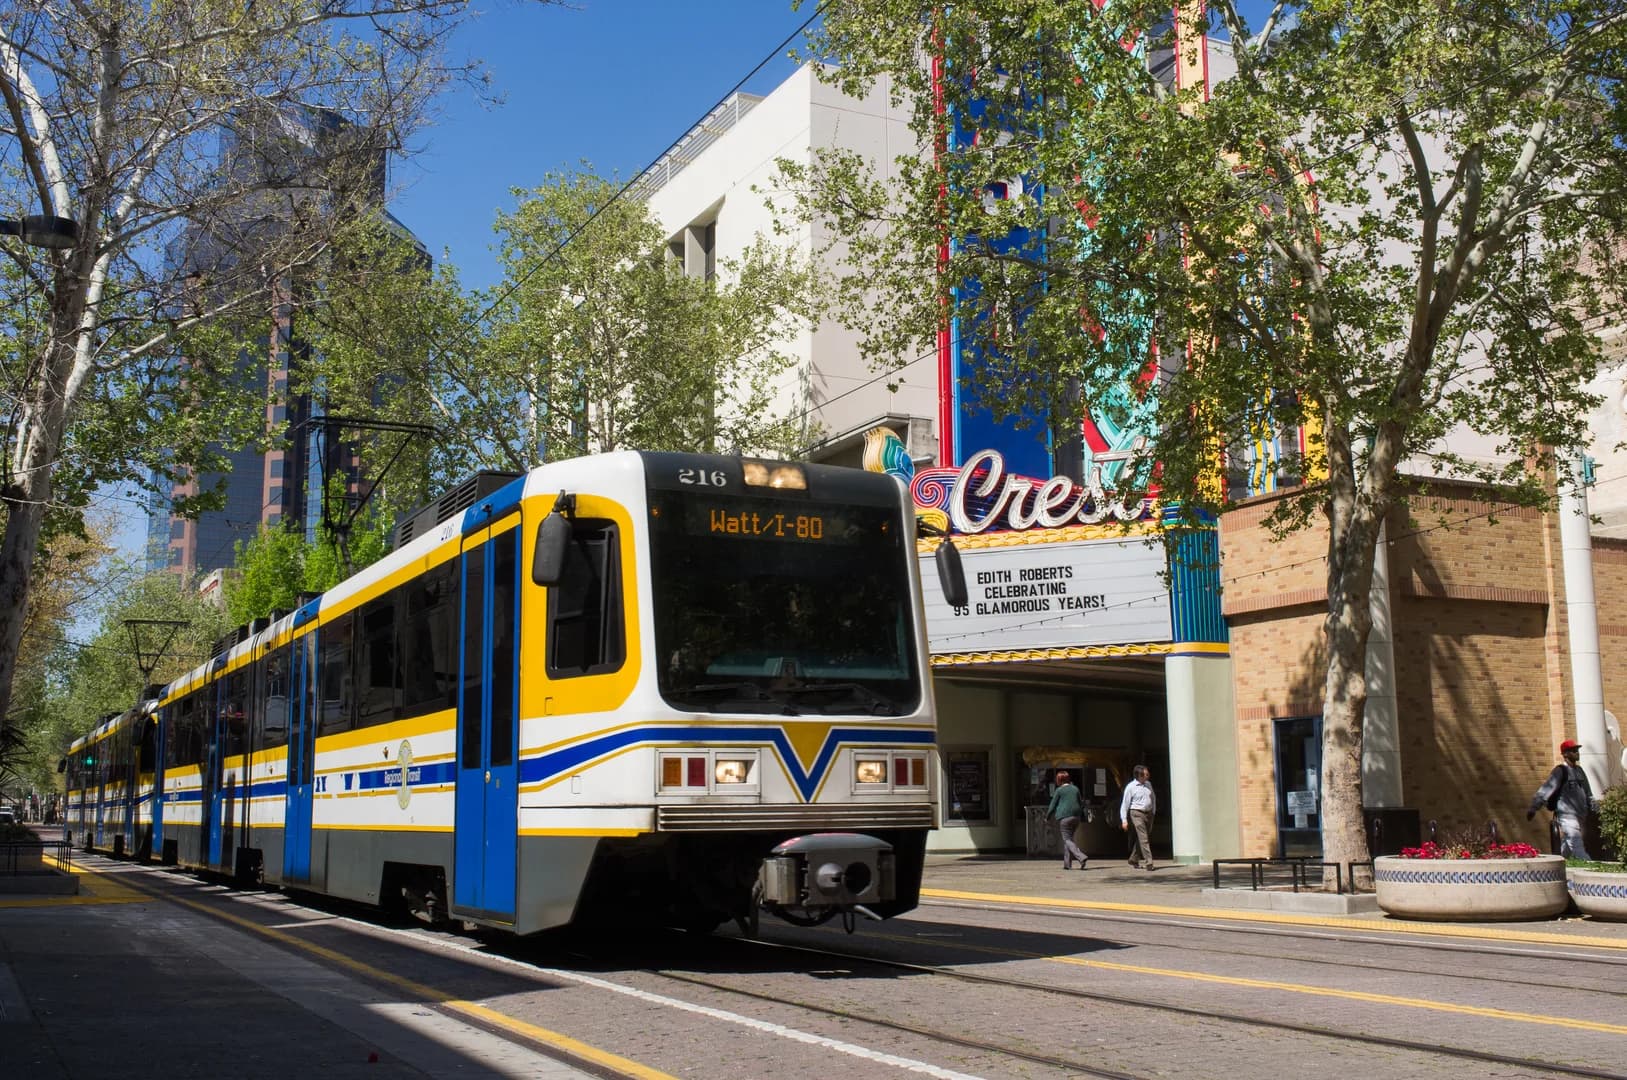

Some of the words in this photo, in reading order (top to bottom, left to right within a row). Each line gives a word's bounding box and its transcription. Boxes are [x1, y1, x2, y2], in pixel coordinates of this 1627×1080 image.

[679, 468, 727, 487] 216
[950, 436, 1153, 533] Crest
[711, 510, 822, 538] Watt/I-80
[977, 570, 1011, 585] EDITH
[1019, 566, 1073, 581] ROBERTS
[984, 582, 1066, 600] CELEBRATING
[953, 604, 969, 616] 95
[976, 599, 1050, 615] GLAMOROUS
[1057, 594, 1105, 610] YEARS!
